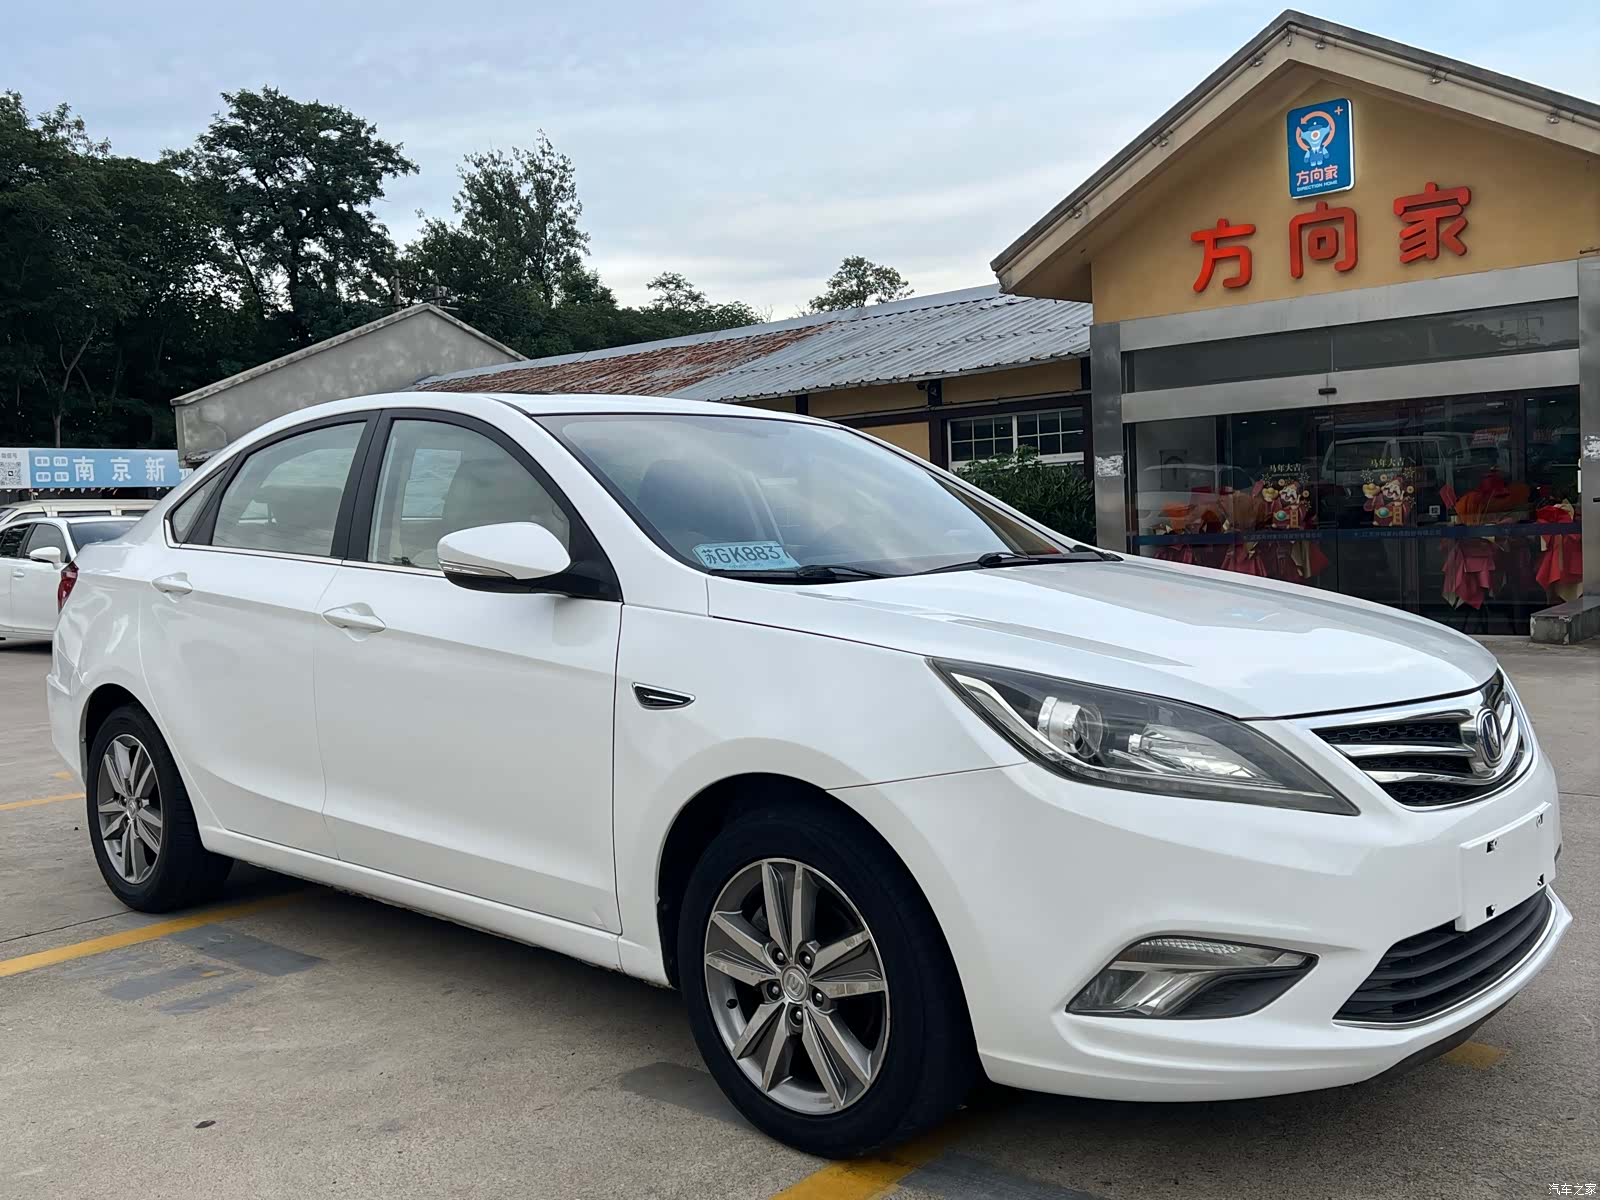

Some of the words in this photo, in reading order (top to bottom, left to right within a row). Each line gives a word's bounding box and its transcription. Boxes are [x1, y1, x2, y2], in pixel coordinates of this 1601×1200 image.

[1296, 165, 1338, 186] 方向家
[1297, 183, 1323, 192] DIRECTION
[1190, 182, 1473, 292] 方向家
